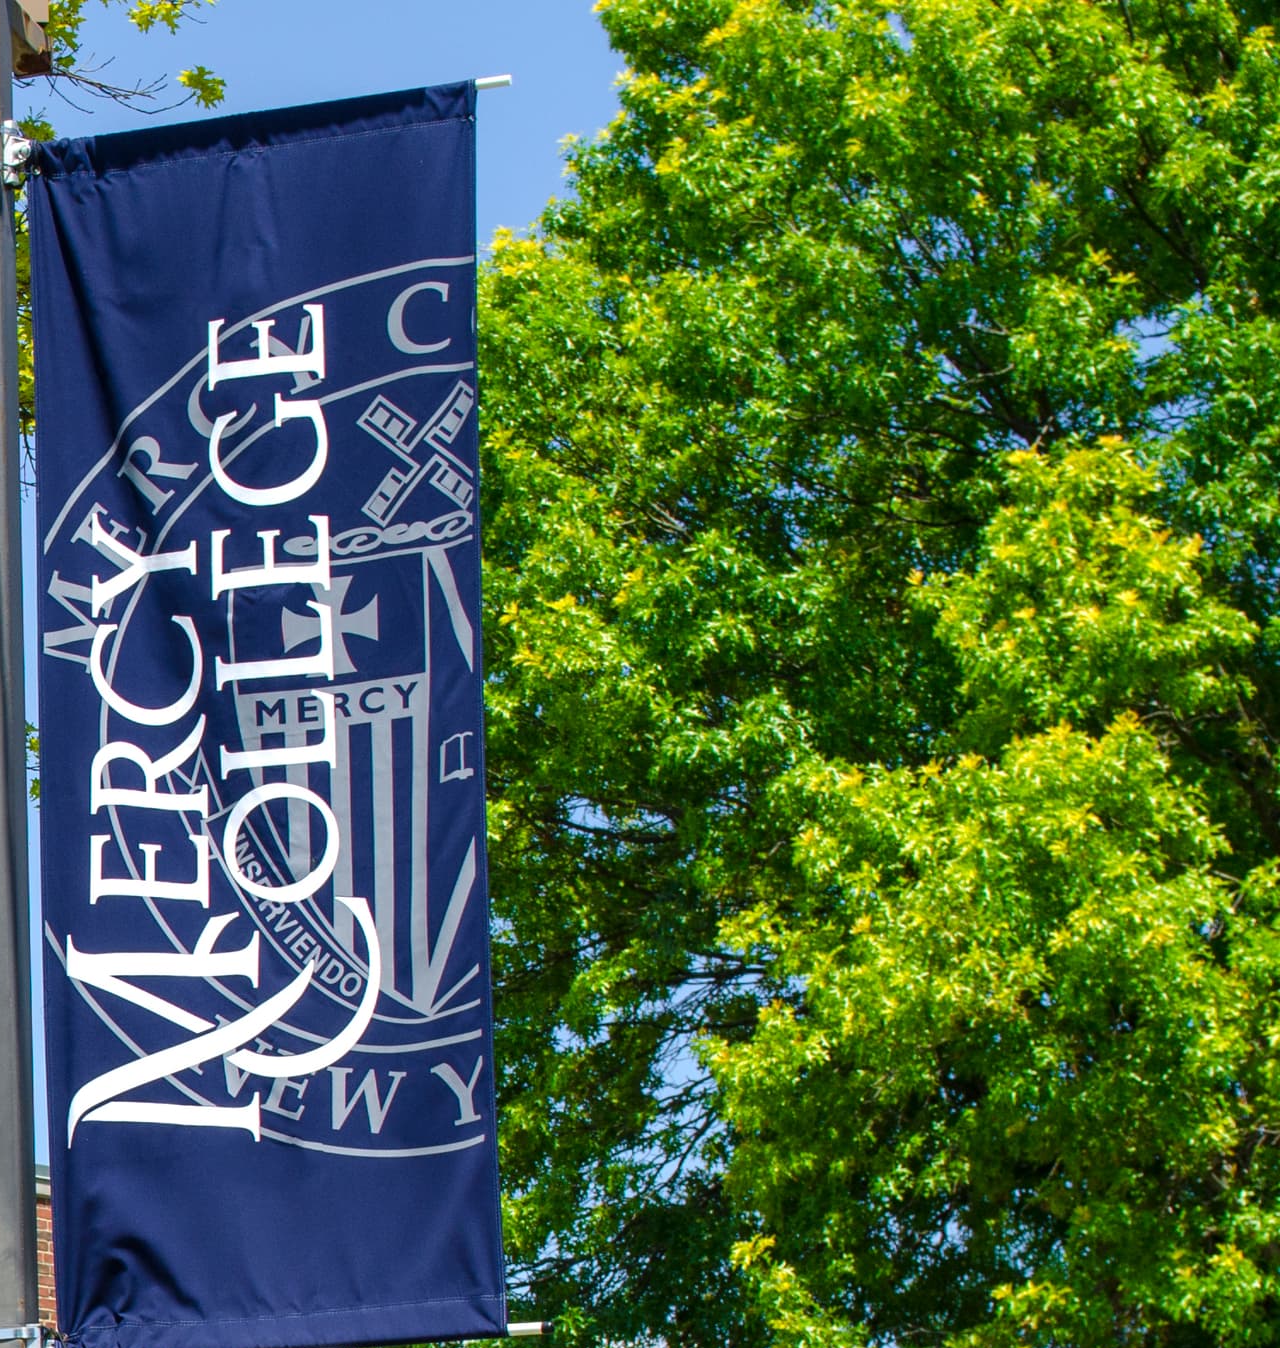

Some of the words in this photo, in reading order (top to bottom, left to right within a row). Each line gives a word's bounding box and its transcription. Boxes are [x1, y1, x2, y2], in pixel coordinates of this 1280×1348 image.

[66, 512, 316, 1149] MERCY
[208, 303, 381, 1078] COLLEGE
[255, 681, 419, 727] MERCY
